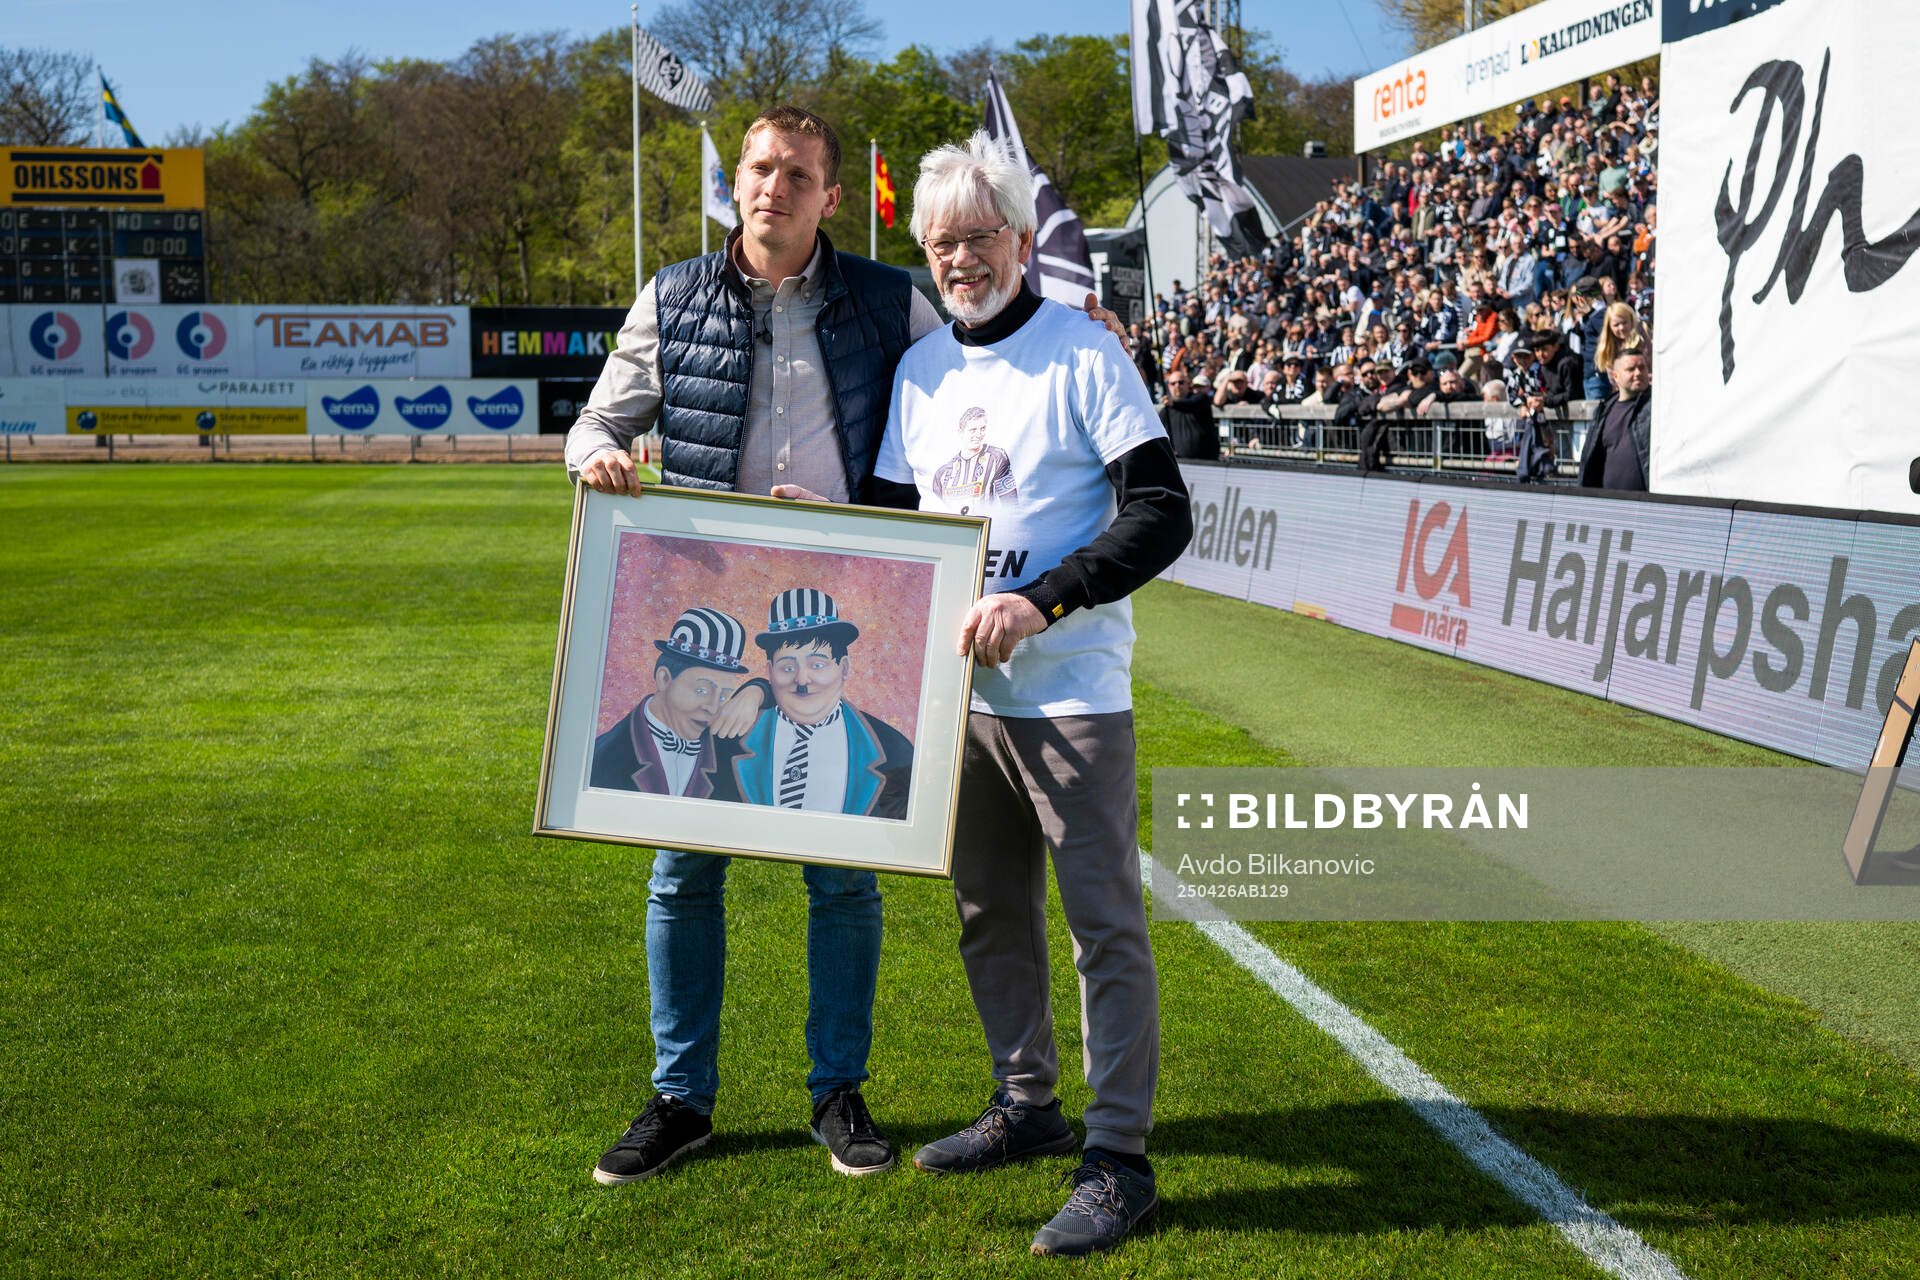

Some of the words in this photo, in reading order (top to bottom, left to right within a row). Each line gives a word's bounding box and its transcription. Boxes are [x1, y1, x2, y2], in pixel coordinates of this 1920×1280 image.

[1374, 66, 1427, 121] renta
[14, 165, 138, 190] OHLSSONS
[255, 313, 457, 348] TEAMAB
[219, 382, 296, 395] PARAJETT
[328, 401, 375, 416] arema
[401, 401, 449, 416] arema
[474, 401, 521, 416] arema
[1395, 499, 1472, 608] ICA
[1423, 605, 1468, 647] nära
